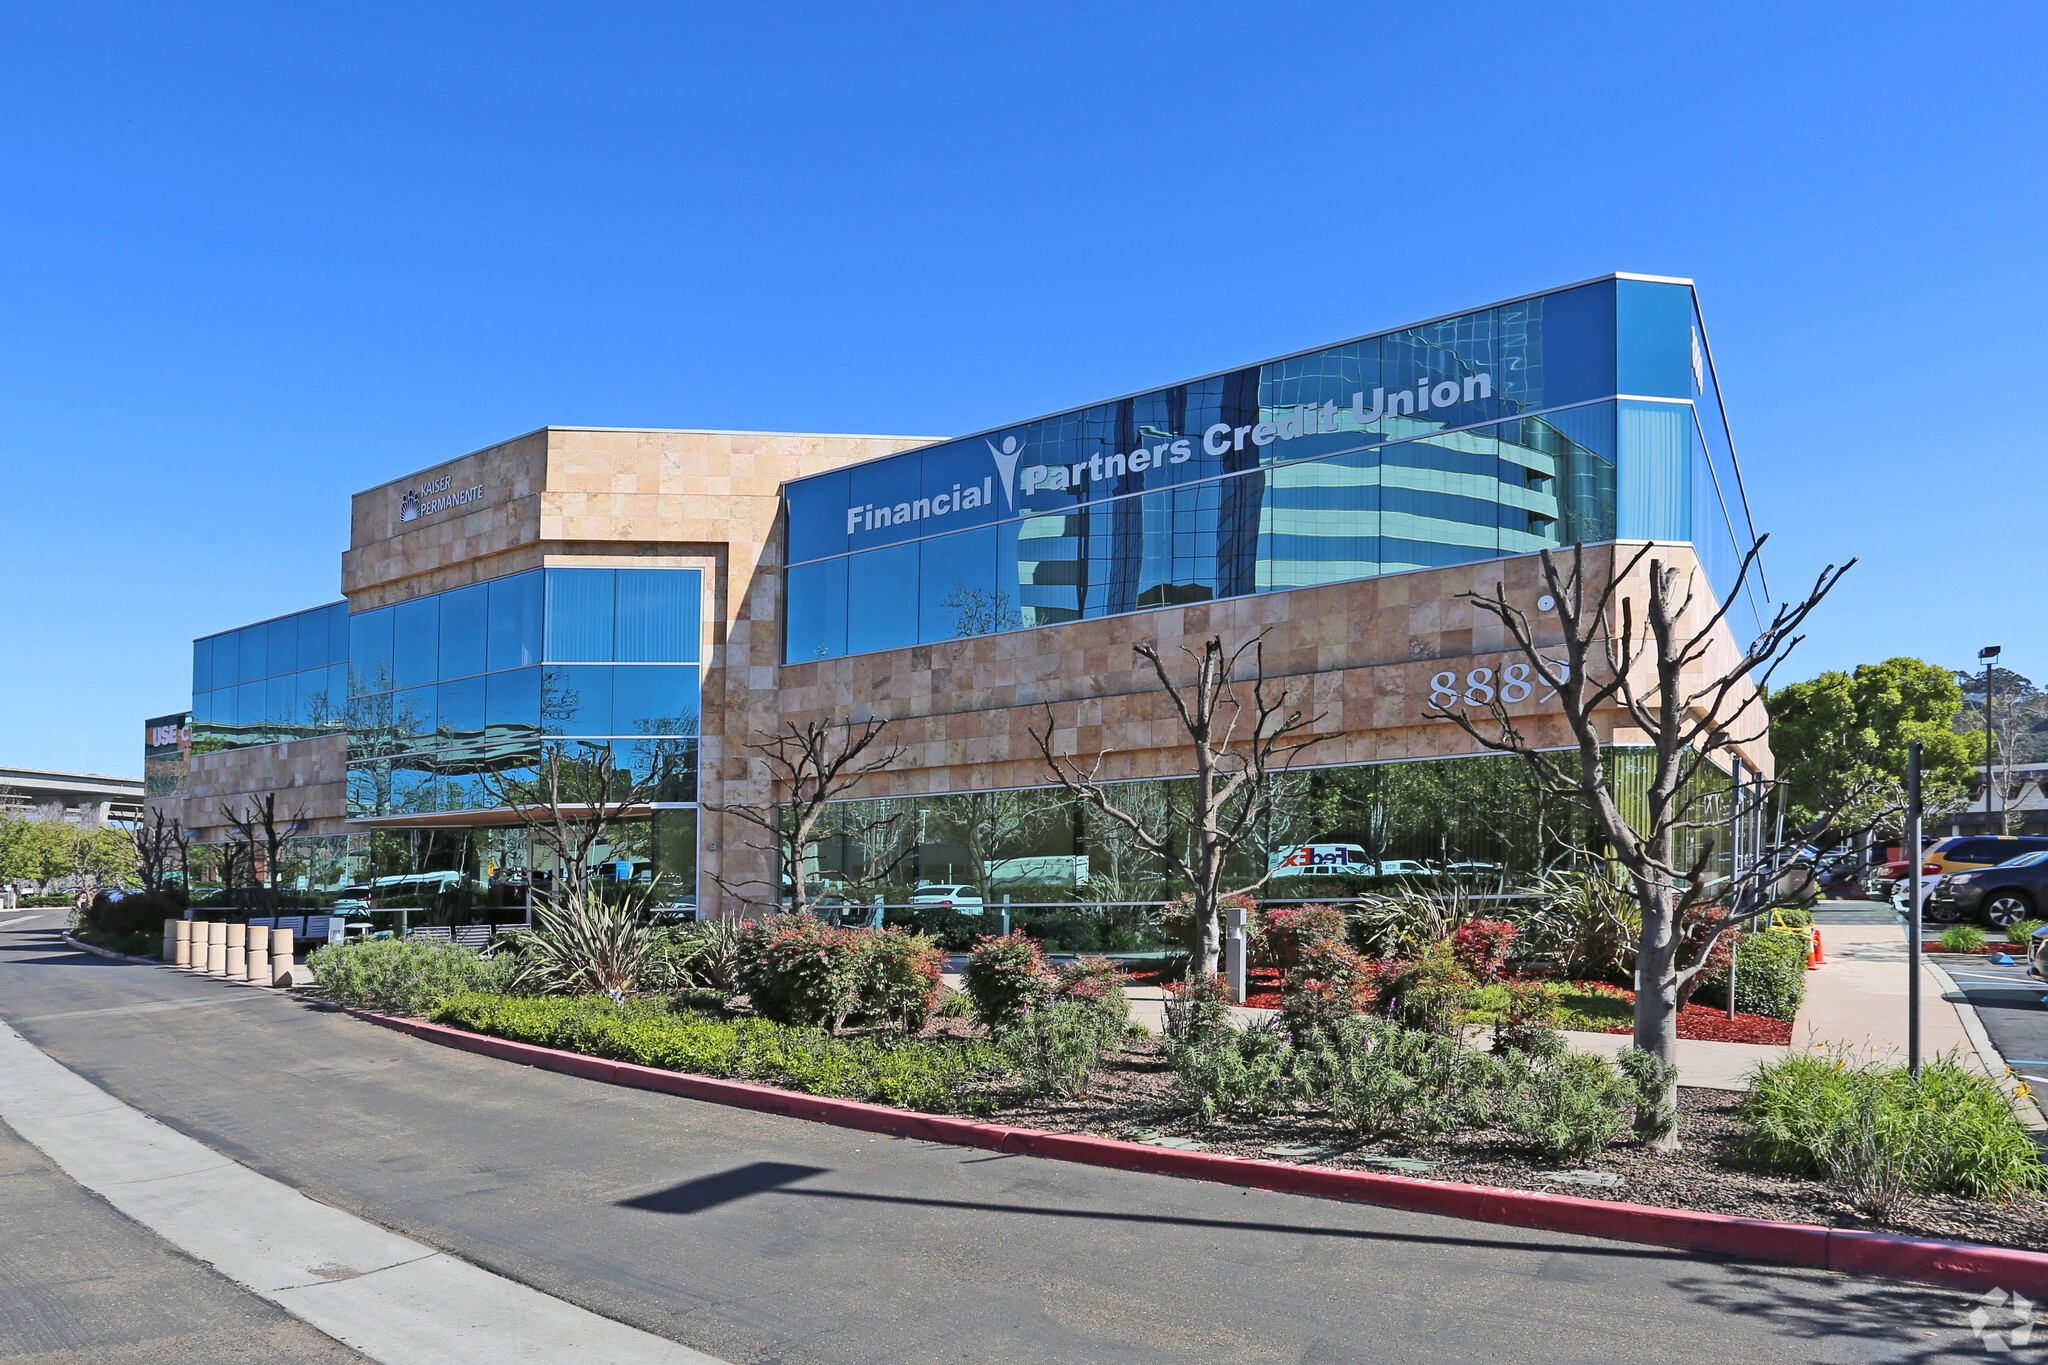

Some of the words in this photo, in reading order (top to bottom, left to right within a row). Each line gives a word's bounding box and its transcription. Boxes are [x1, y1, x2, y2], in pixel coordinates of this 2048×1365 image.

[847, 475, 993, 535] Financial
[1025, 438, 1193, 496] Partners
[1203, 398, 1339, 456] Credit
[1352, 372, 1492, 424] Union
[421, 476, 452, 497] KAISER
[420, 485, 484, 517] PERMANENTE
[1427, 659, 1571, 710] 8889
[153, 724, 178, 747] USE
[1386, 1174, 1452, 1187] FIRE
[1472, 1184, 1549, 1198] LANE
